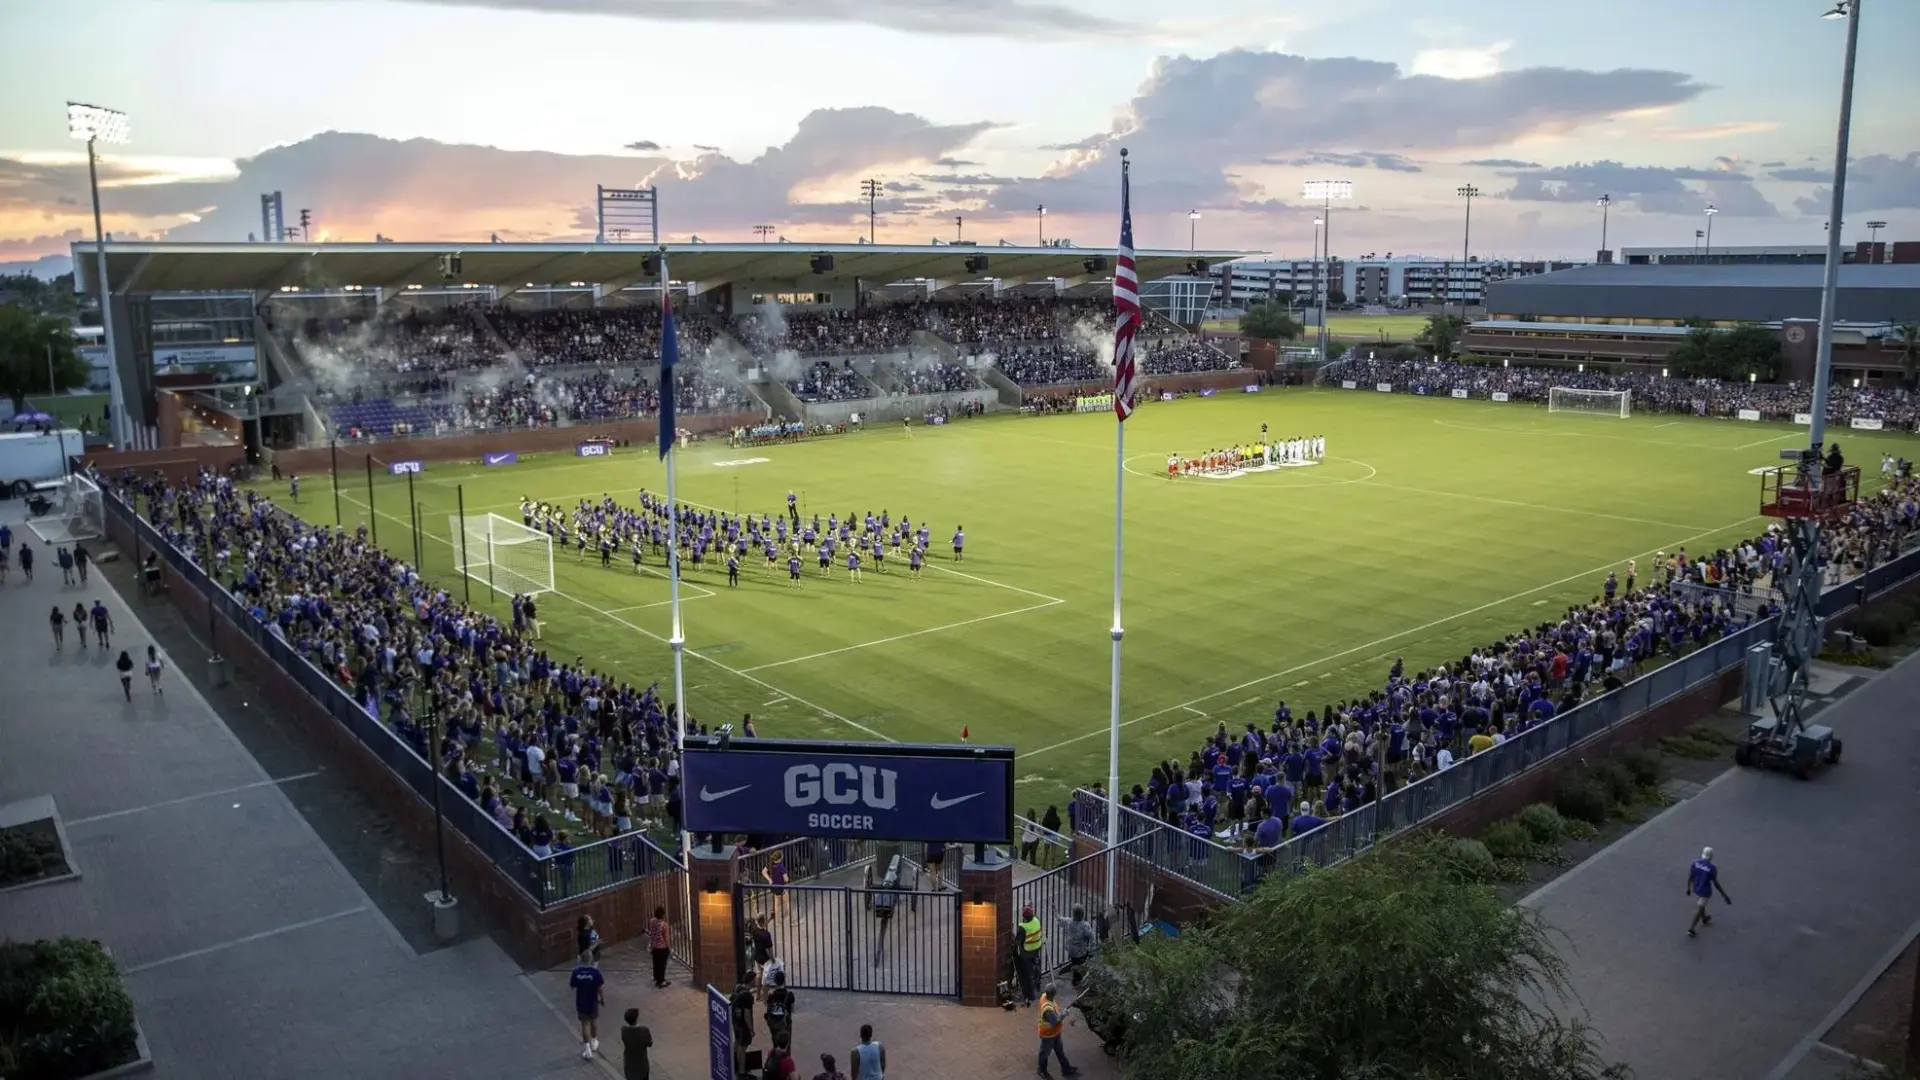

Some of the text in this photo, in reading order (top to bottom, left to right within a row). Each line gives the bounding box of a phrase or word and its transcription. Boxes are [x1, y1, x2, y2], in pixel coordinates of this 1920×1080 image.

[582, 445, 603, 456] GCU
[394, 461, 420, 474] GCU
[784, 763, 897, 810] GCU
[808, 813, 874, 830] SOCCER
